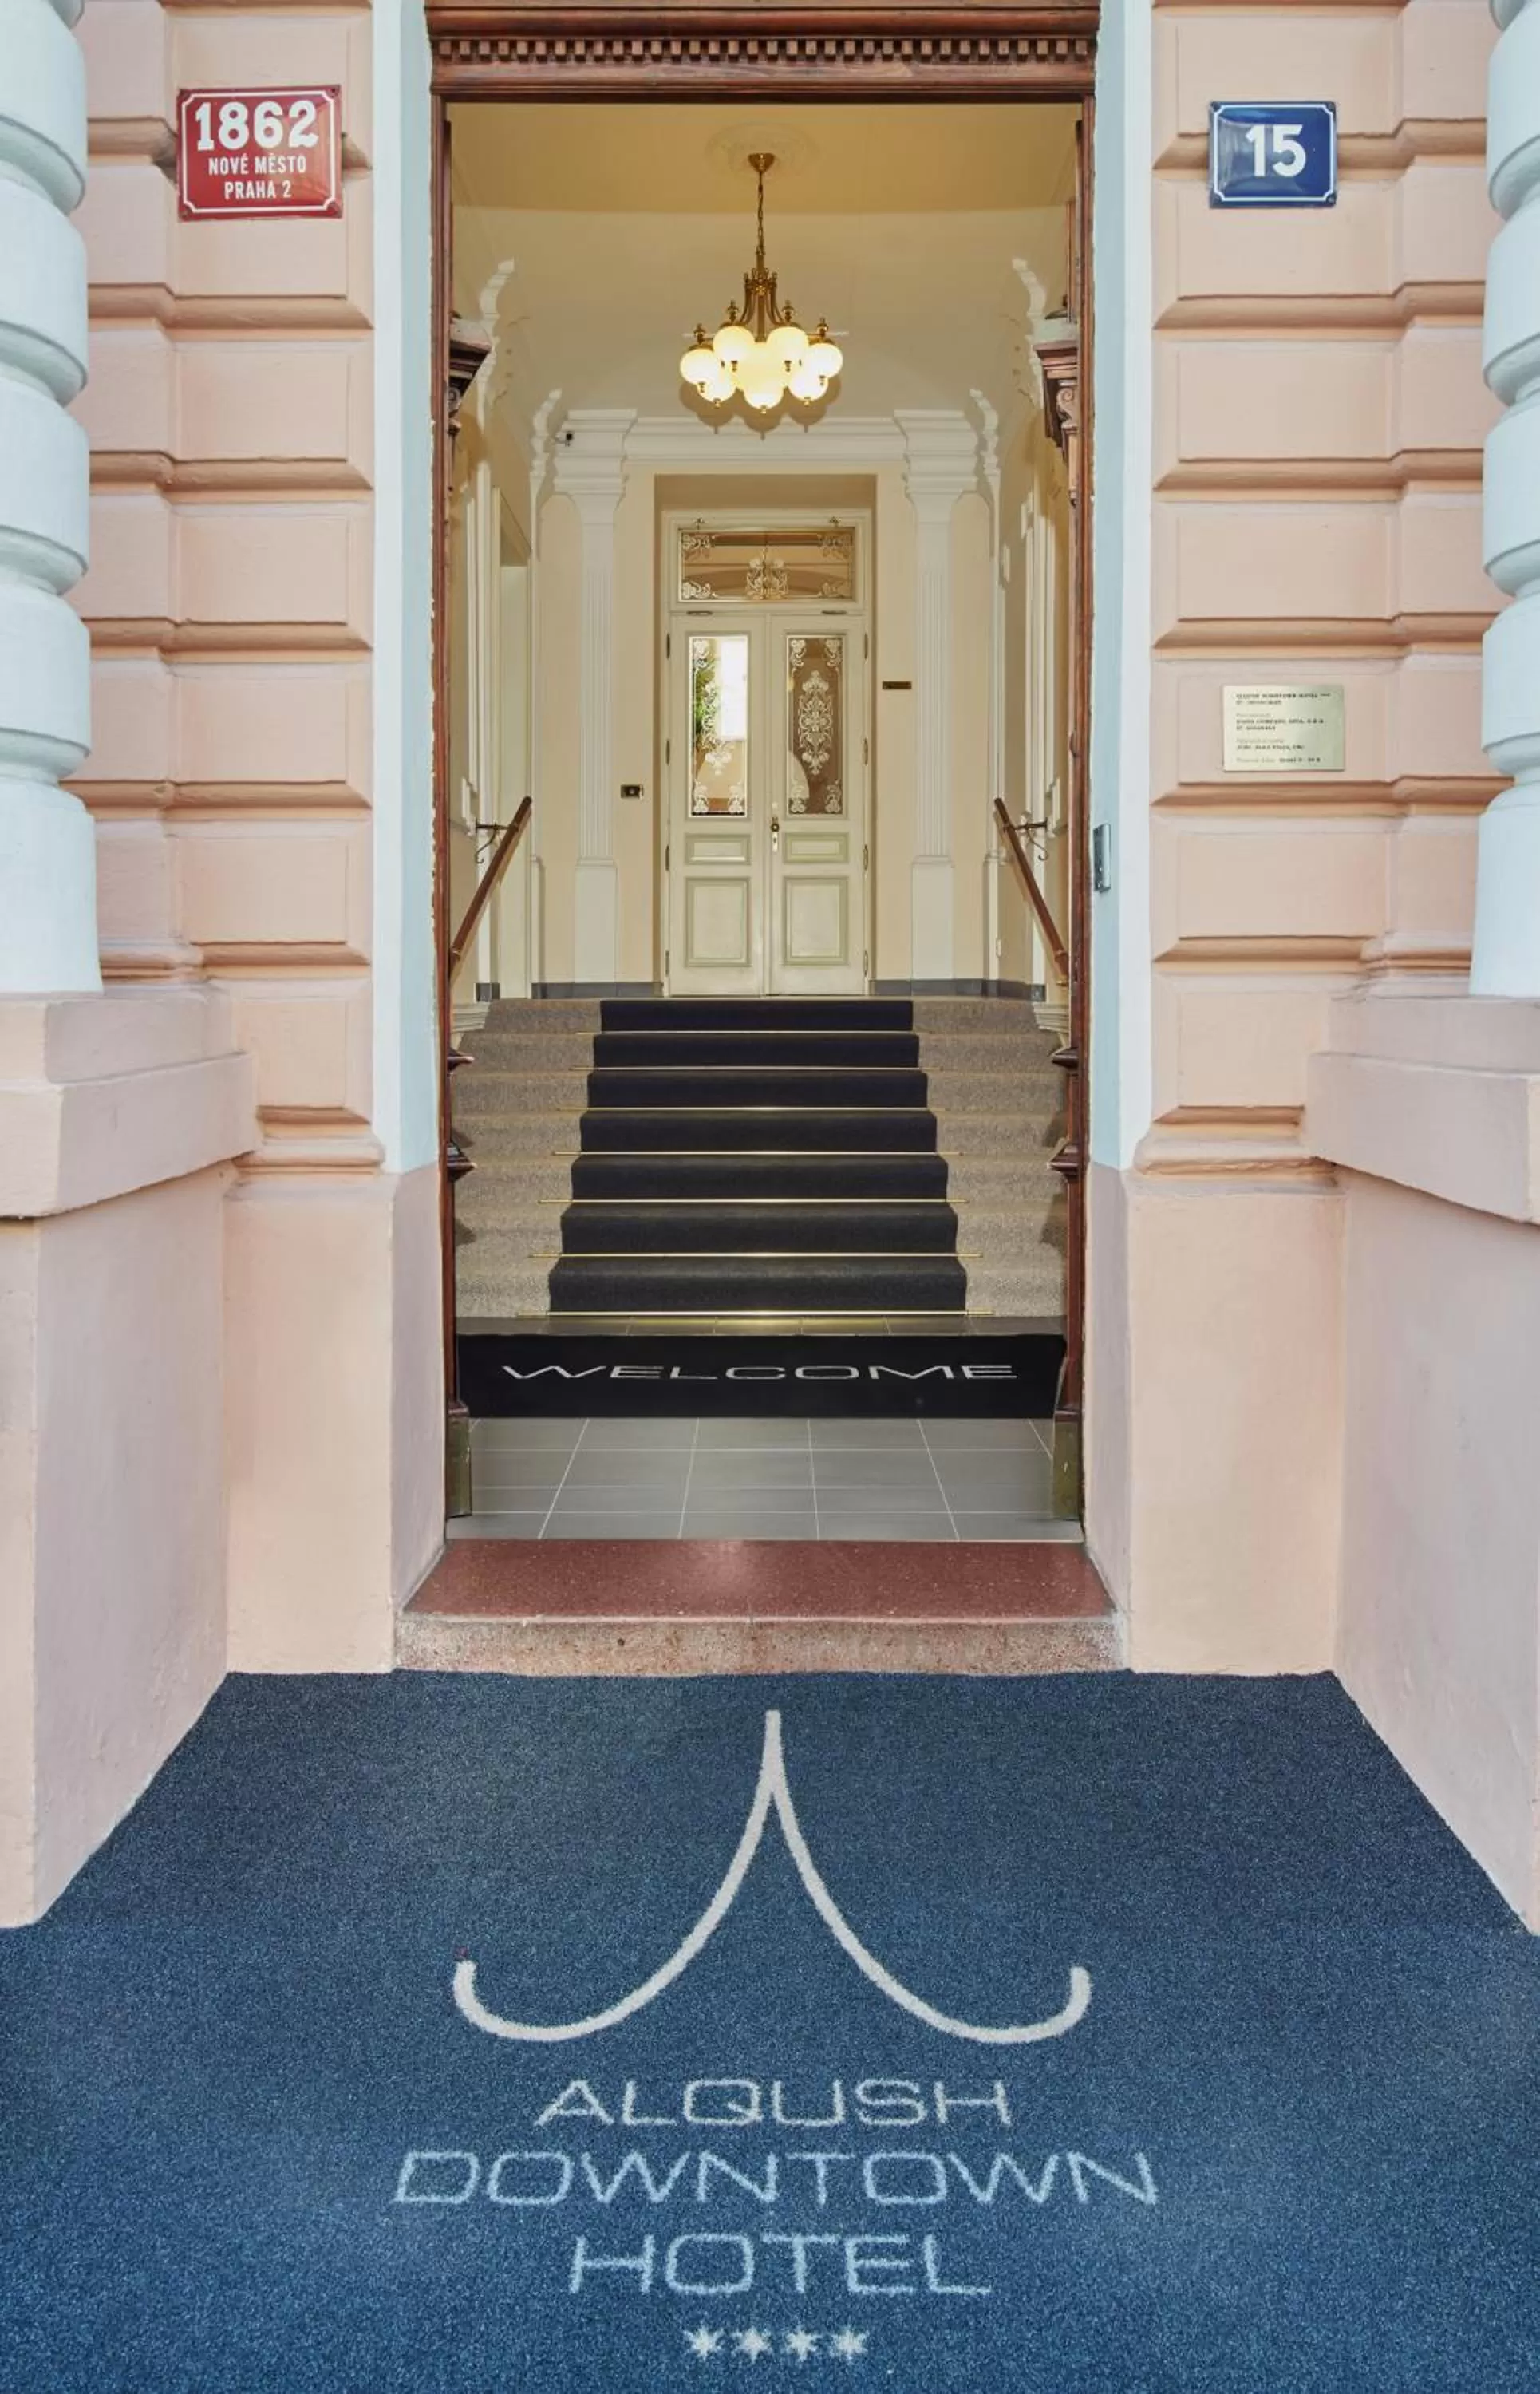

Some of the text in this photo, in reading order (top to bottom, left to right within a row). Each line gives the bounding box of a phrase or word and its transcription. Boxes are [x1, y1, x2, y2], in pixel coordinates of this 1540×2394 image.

[195, 100, 318, 151] 1862
[1245, 124, 1306, 177] 15
[208, 153, 249, 176] NOVÉ
[224, 180, 292, 200] PRAHA 2
[501, 1365, 1017, 1380] WELCOME
[534, 2077, 1013, 2128] ALQUSH
[392, 2149, 1159, 2206] DOWNTOWN
[568, 2232, 991, 2297] HOTEL
